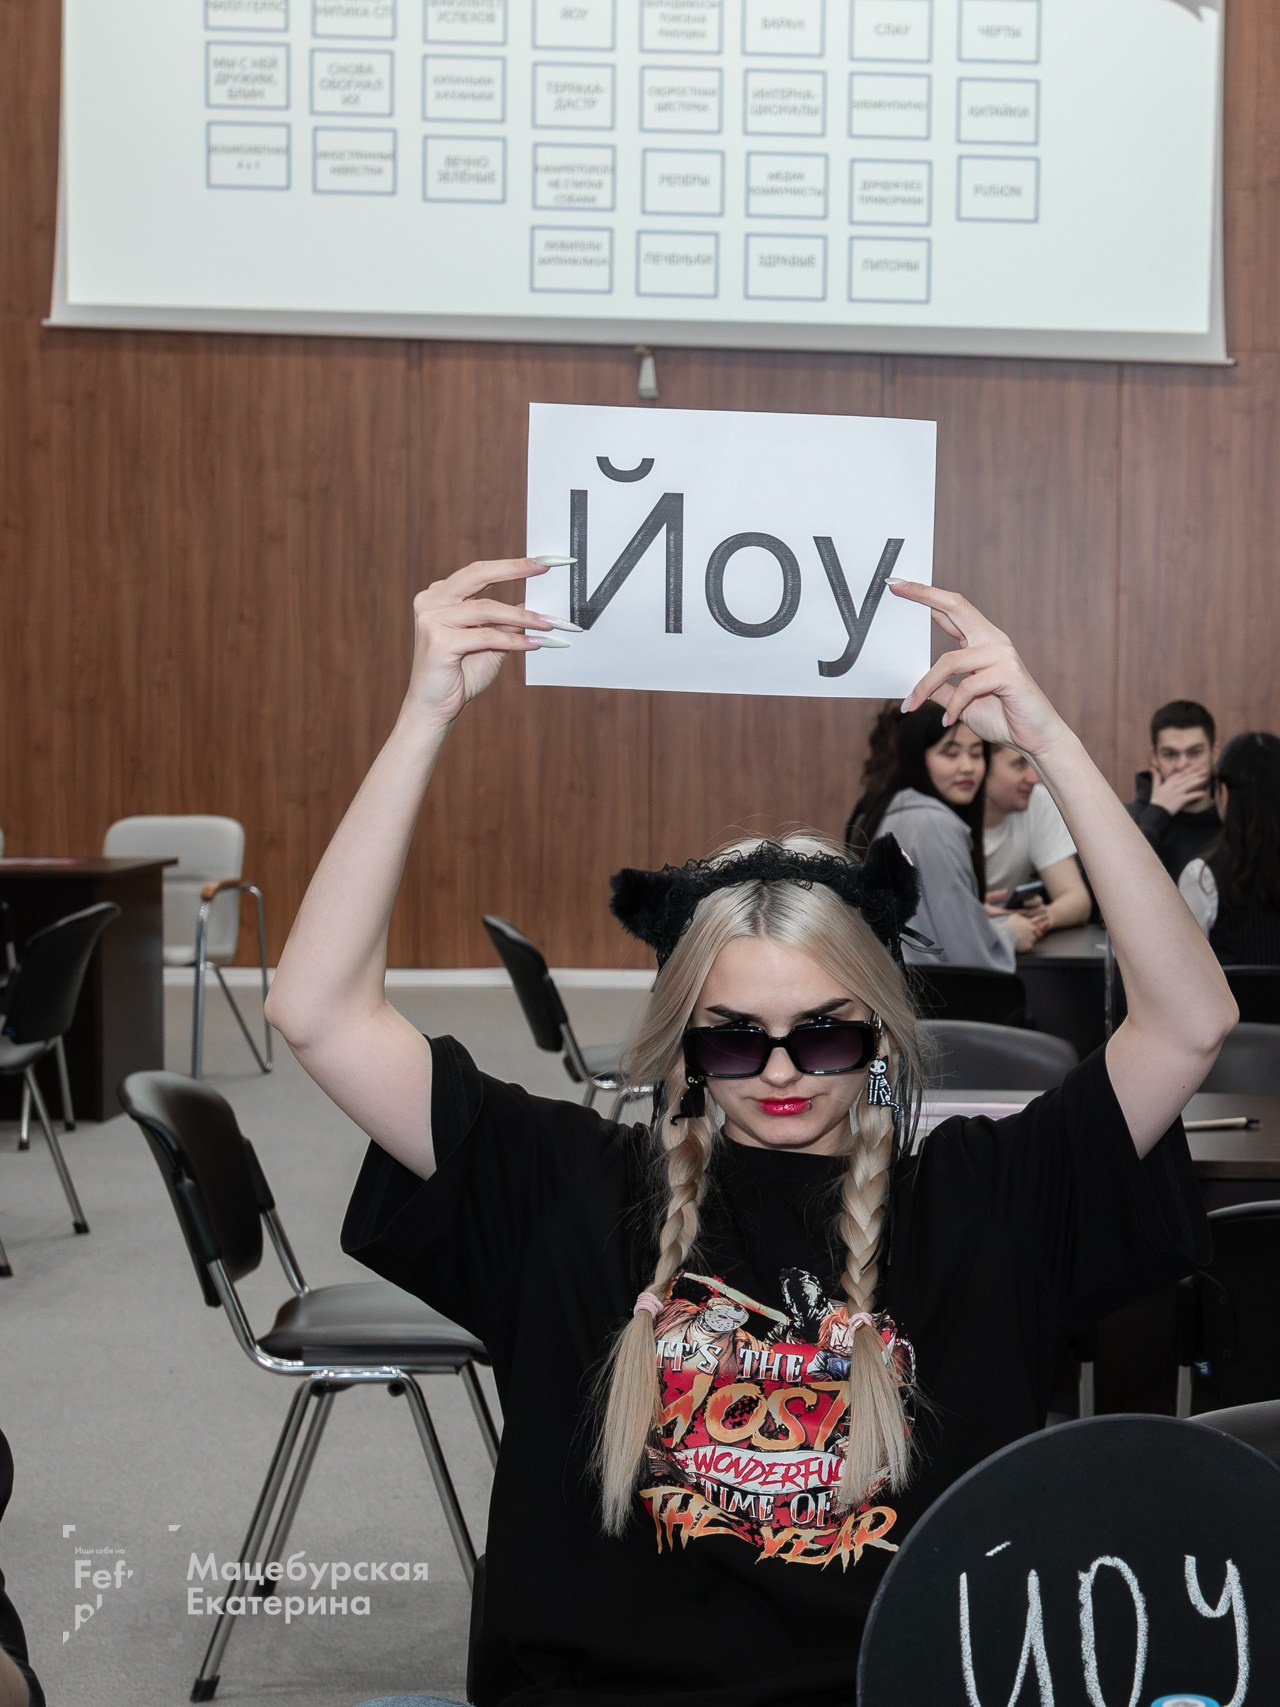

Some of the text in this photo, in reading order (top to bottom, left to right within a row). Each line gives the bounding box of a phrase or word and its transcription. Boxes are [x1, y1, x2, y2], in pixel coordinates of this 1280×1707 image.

[569, 455, 906, 678] Йоу
[738, 1345, 804, 1384] THE
[639, 1485, 900, 1574] THE YEAR
[703, 1478, 834, 1528] TIME OF
